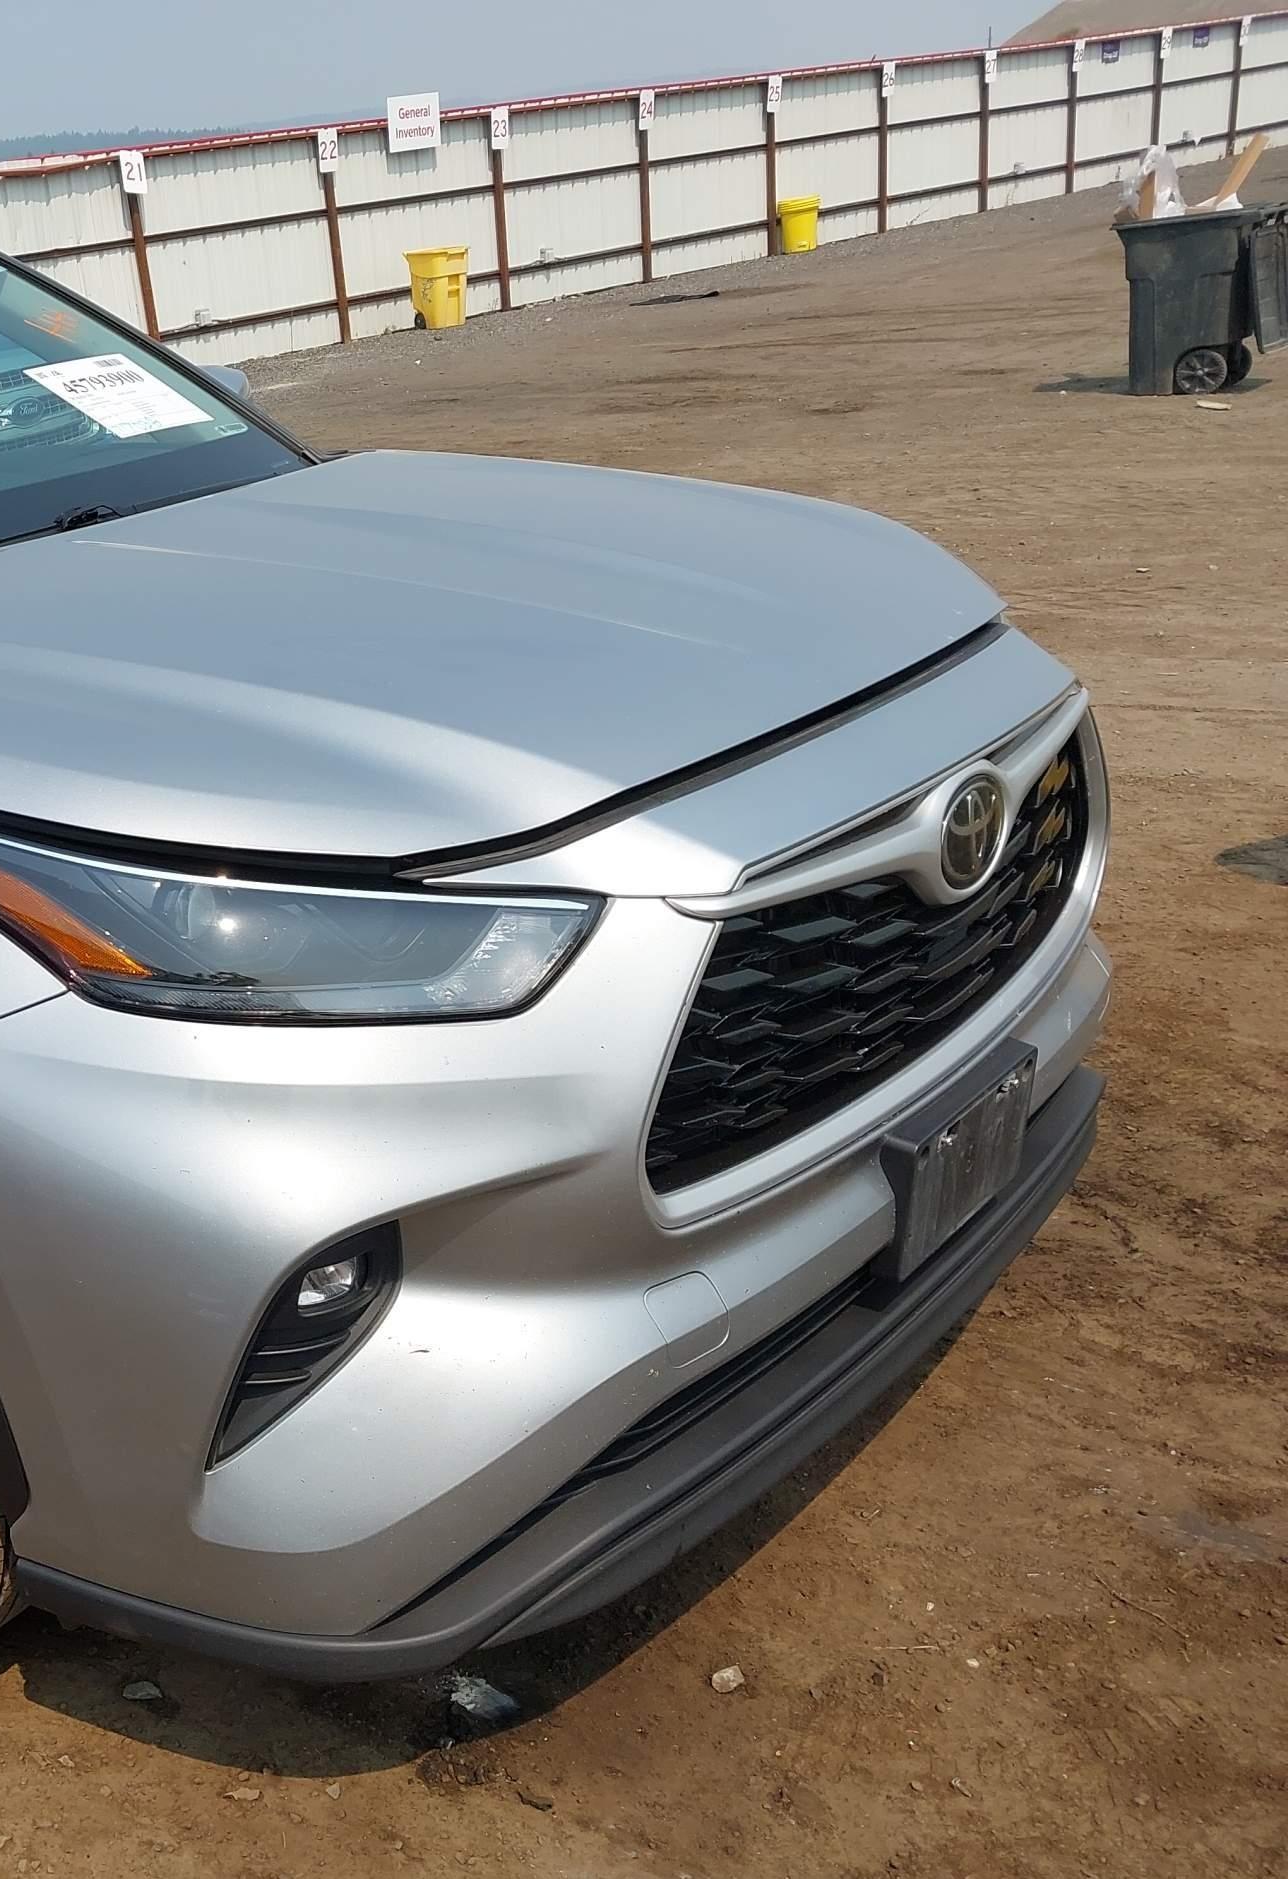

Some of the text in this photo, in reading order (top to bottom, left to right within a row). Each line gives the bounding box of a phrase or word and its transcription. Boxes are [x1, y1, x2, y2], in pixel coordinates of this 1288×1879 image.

[1073, 48, 1083, 63] 28
[985, 58, 997, 73] 27
[882, 71, 895, 87] 26
[768, 85, 780, 102] 25
[398, 105, 431, 120] General
[640, 102, 653, 119] 24
[395, 124, 435, 139] Inventory
[492, 119, 507, 138] 23
[319, 140, 337, 160] 22
[124, 161, 143, 182] 21
[62, 369, 145, 394] 45793900
[19, 402, 38, 416] Ford
